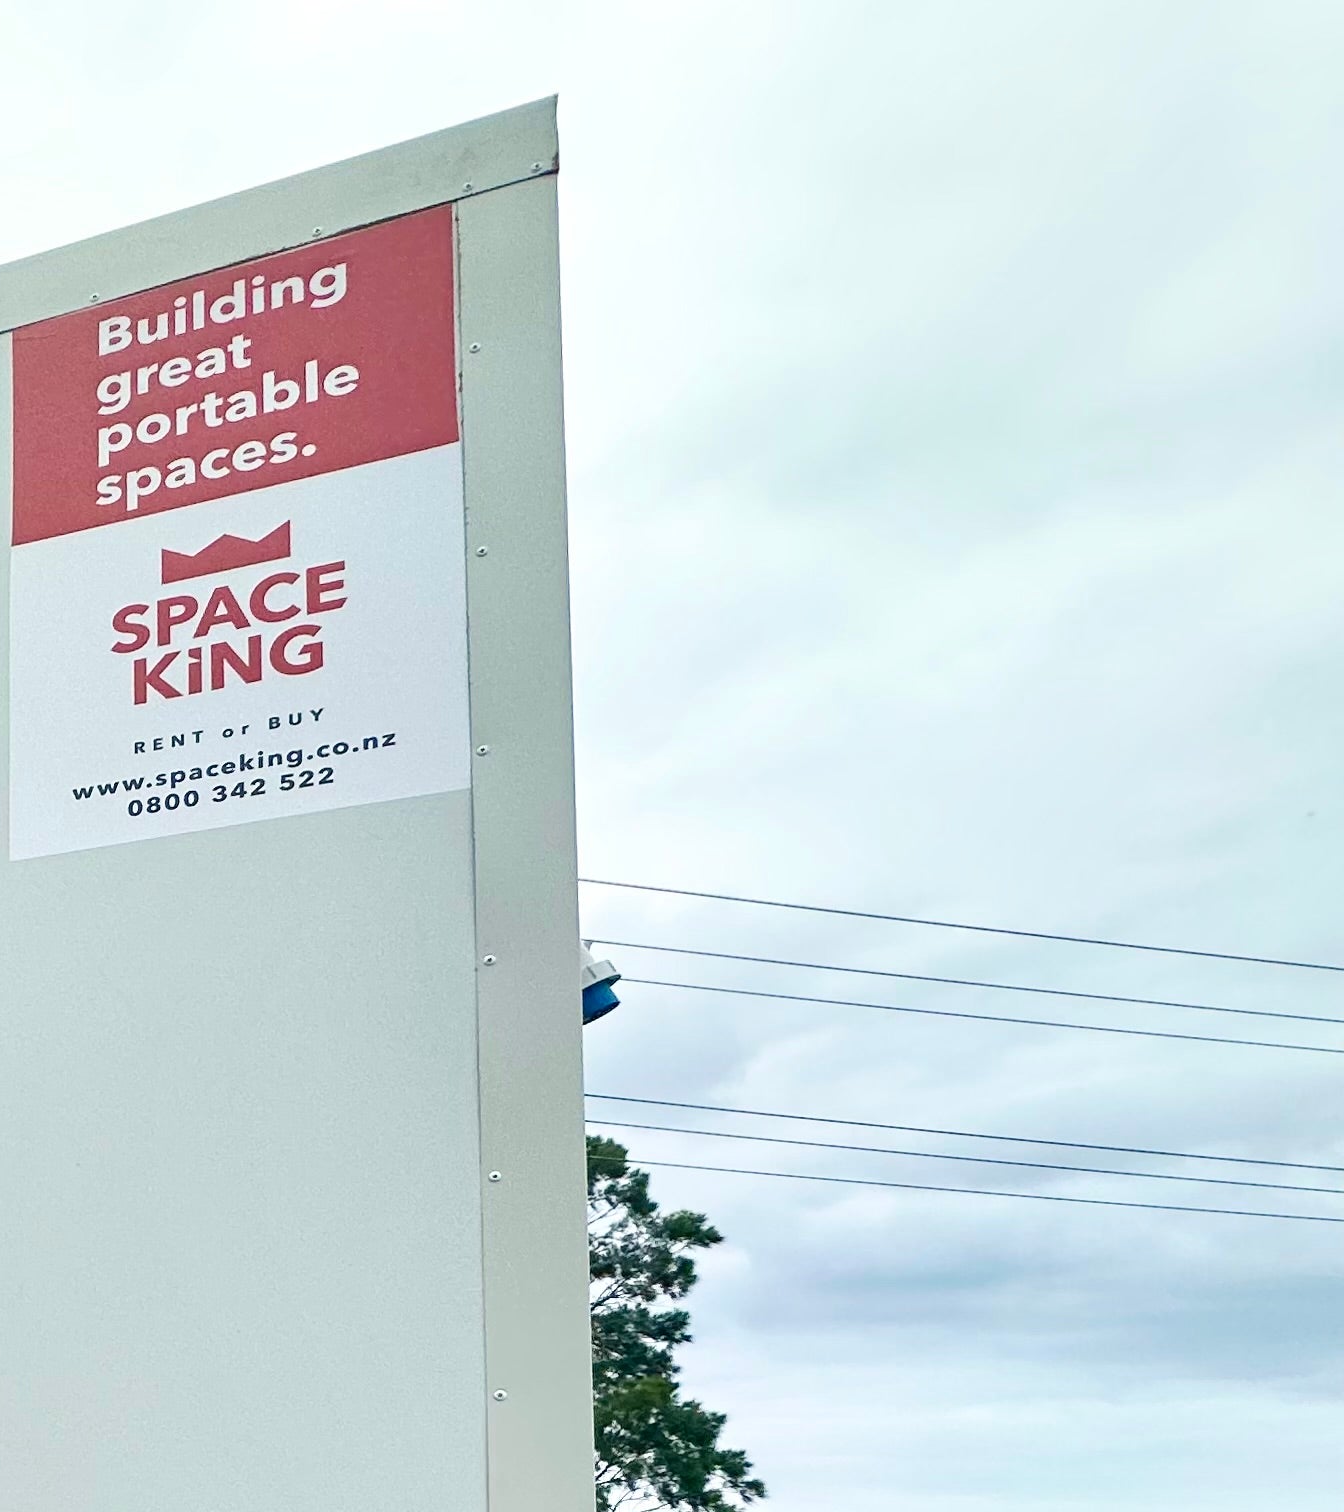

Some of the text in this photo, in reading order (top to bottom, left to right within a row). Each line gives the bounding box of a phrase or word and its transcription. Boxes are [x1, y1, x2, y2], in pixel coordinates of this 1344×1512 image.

[97, 262, 349, 356] Building
[96, 333, 252, 414] great
[97, 361, 360, 466] portable
[95, 430, 318, 511] spaces.
[111, 561, 348, 653] SPACE
[73, 733, 397, 800] www.spaceking.co.nz
[134, 708, 325, 754] RENT or BUY
[128, 767, 335, 817] 0800 342 522
